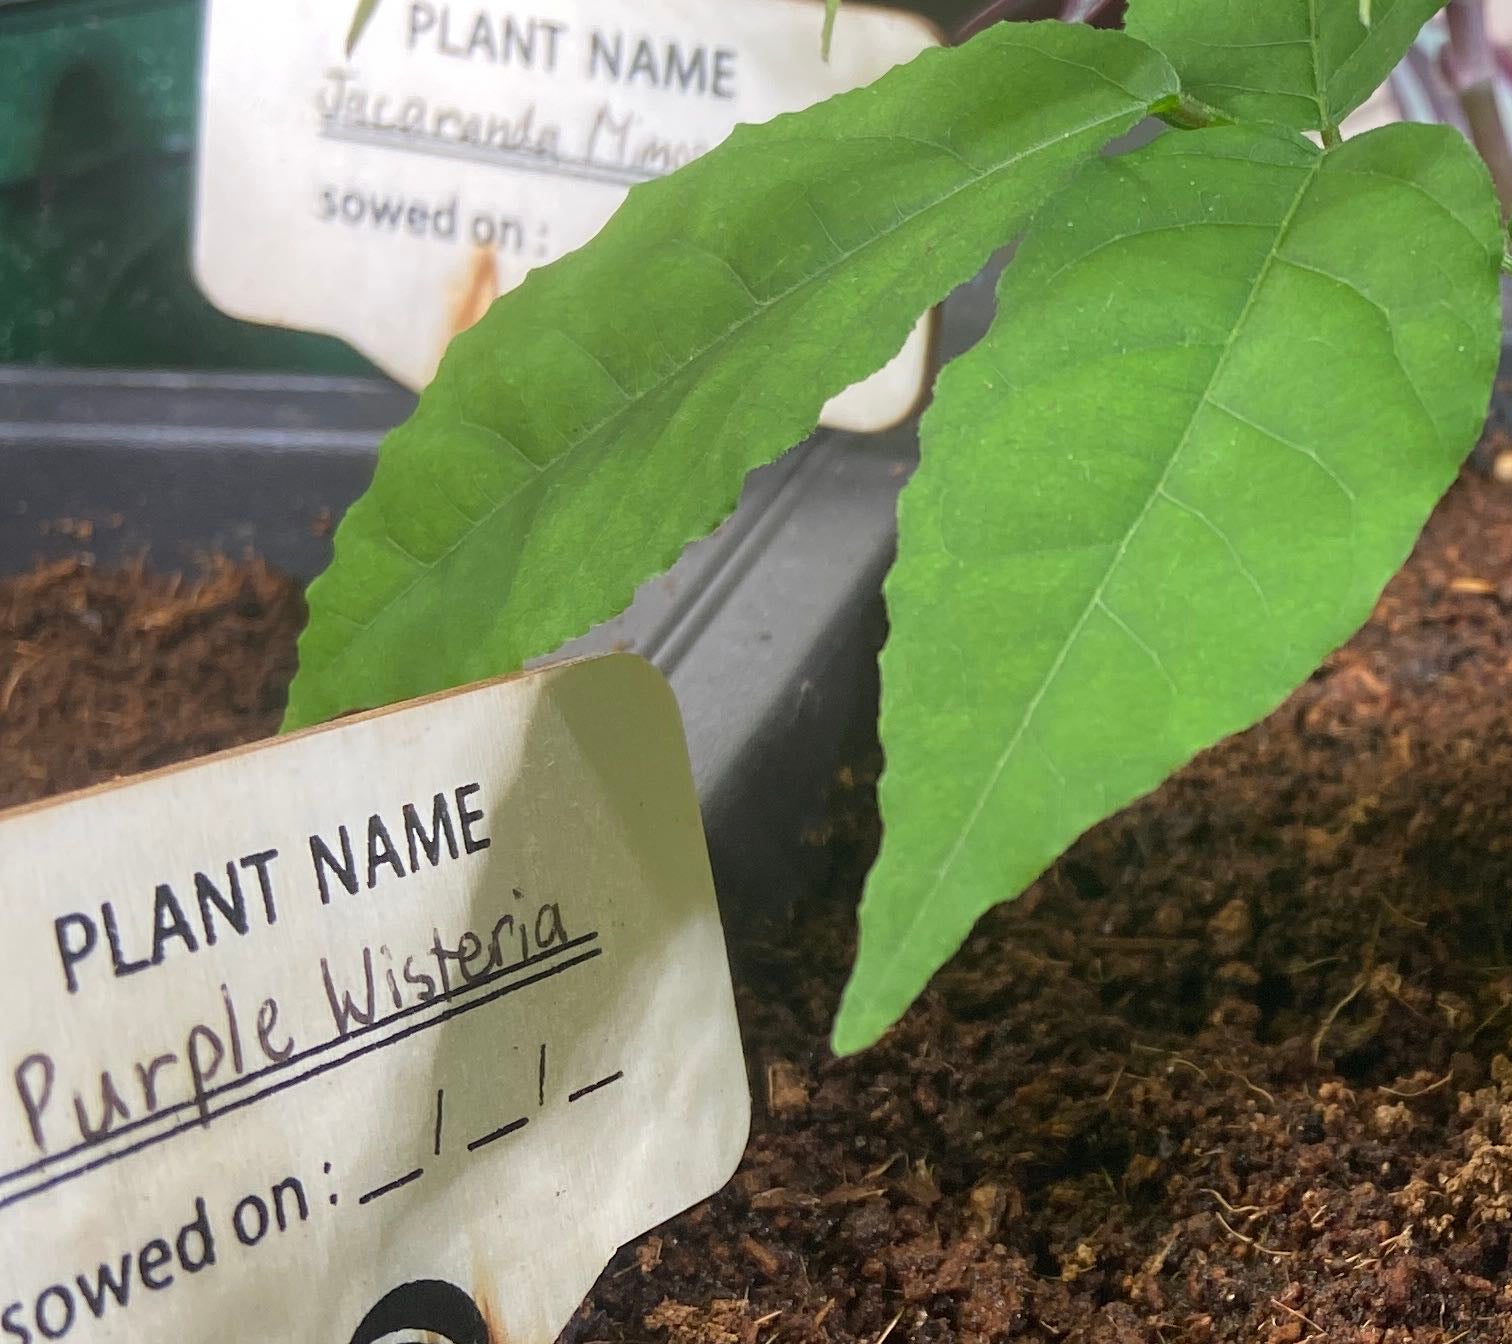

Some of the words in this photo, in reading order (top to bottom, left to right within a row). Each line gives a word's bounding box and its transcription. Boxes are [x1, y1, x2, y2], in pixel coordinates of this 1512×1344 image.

[408, 0, 566, 71] PLANT
[588, 30, 740, 100] NAME
[318, 184, 458, 244] sowed
[54, 848, 280, 994] PLANT
[308, 781, 492, 905] NAME
[13, 983, 296, 1150] Purple
[320, 889, 570, 1038] Wisteria
